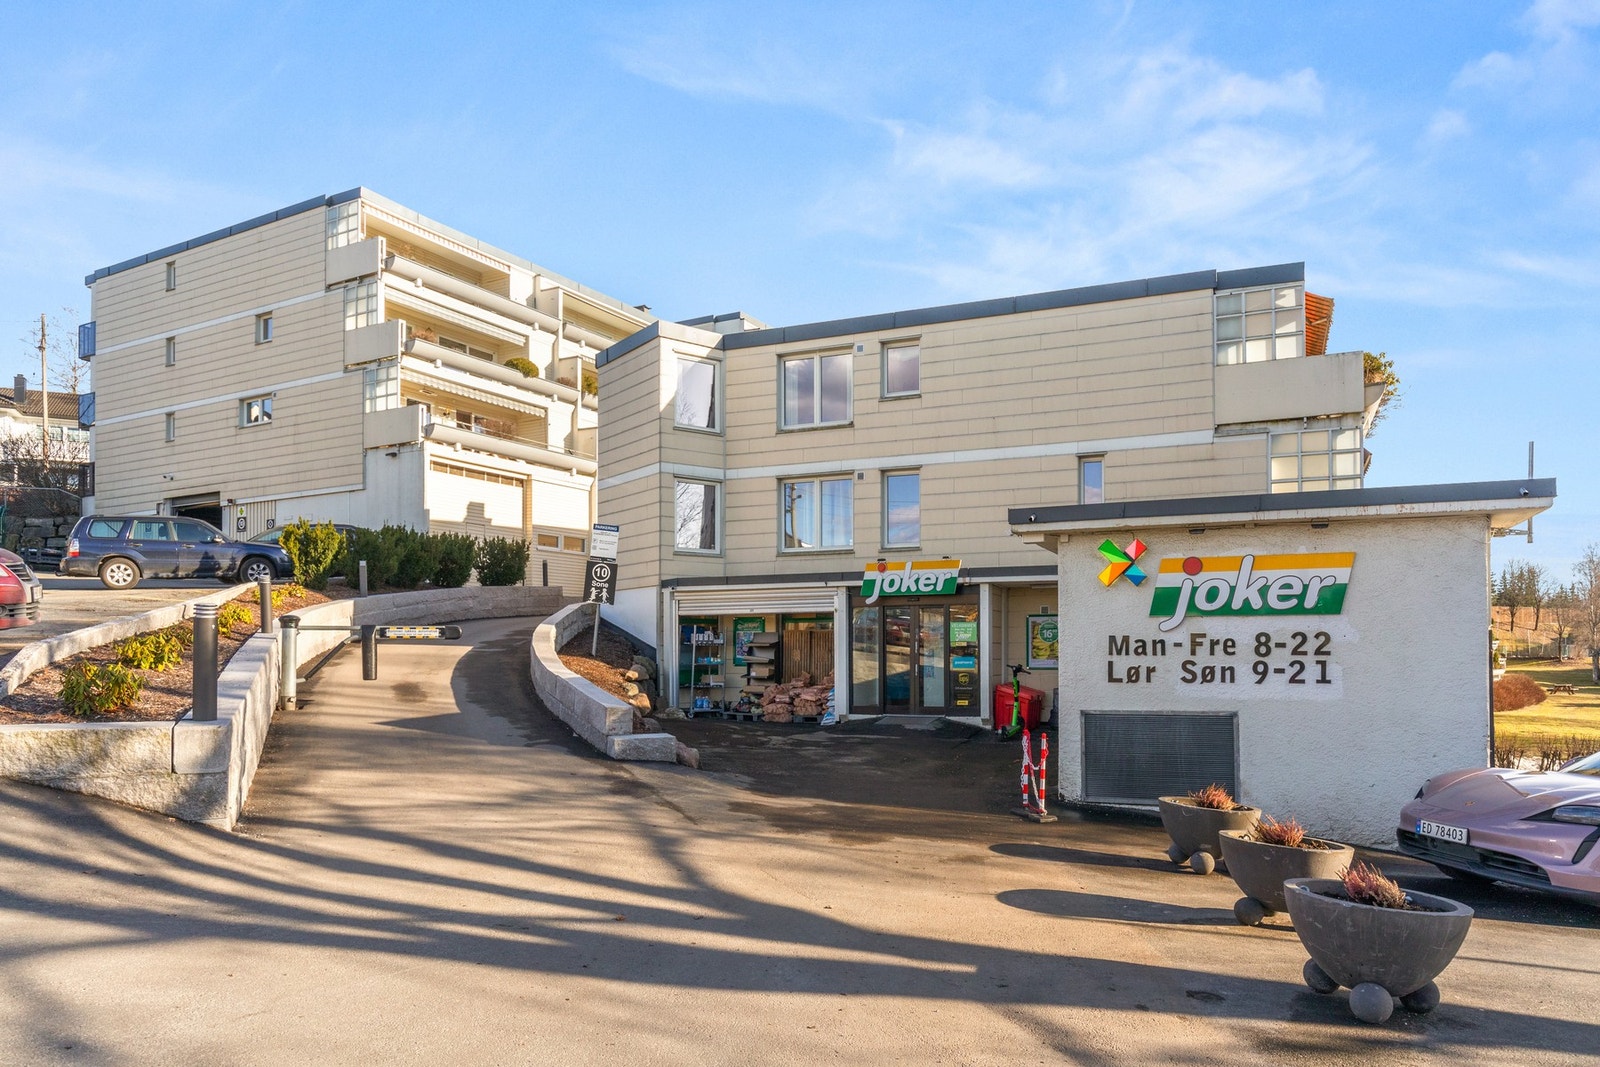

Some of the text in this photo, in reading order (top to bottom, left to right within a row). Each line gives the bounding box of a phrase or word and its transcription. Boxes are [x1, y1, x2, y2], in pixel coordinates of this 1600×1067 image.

[591, 580, 609, 588] Sone
[595, 567, 608, 577] 10
[865, 562, 953, 605] joker
[1158, 554, 1336, 632] joker
[1254, 631, 1331, 657] 8-22
[1107, 660, 1332, 684] Lør Søn 9-21
[1422, 822, 1464, 841] ED 78403
